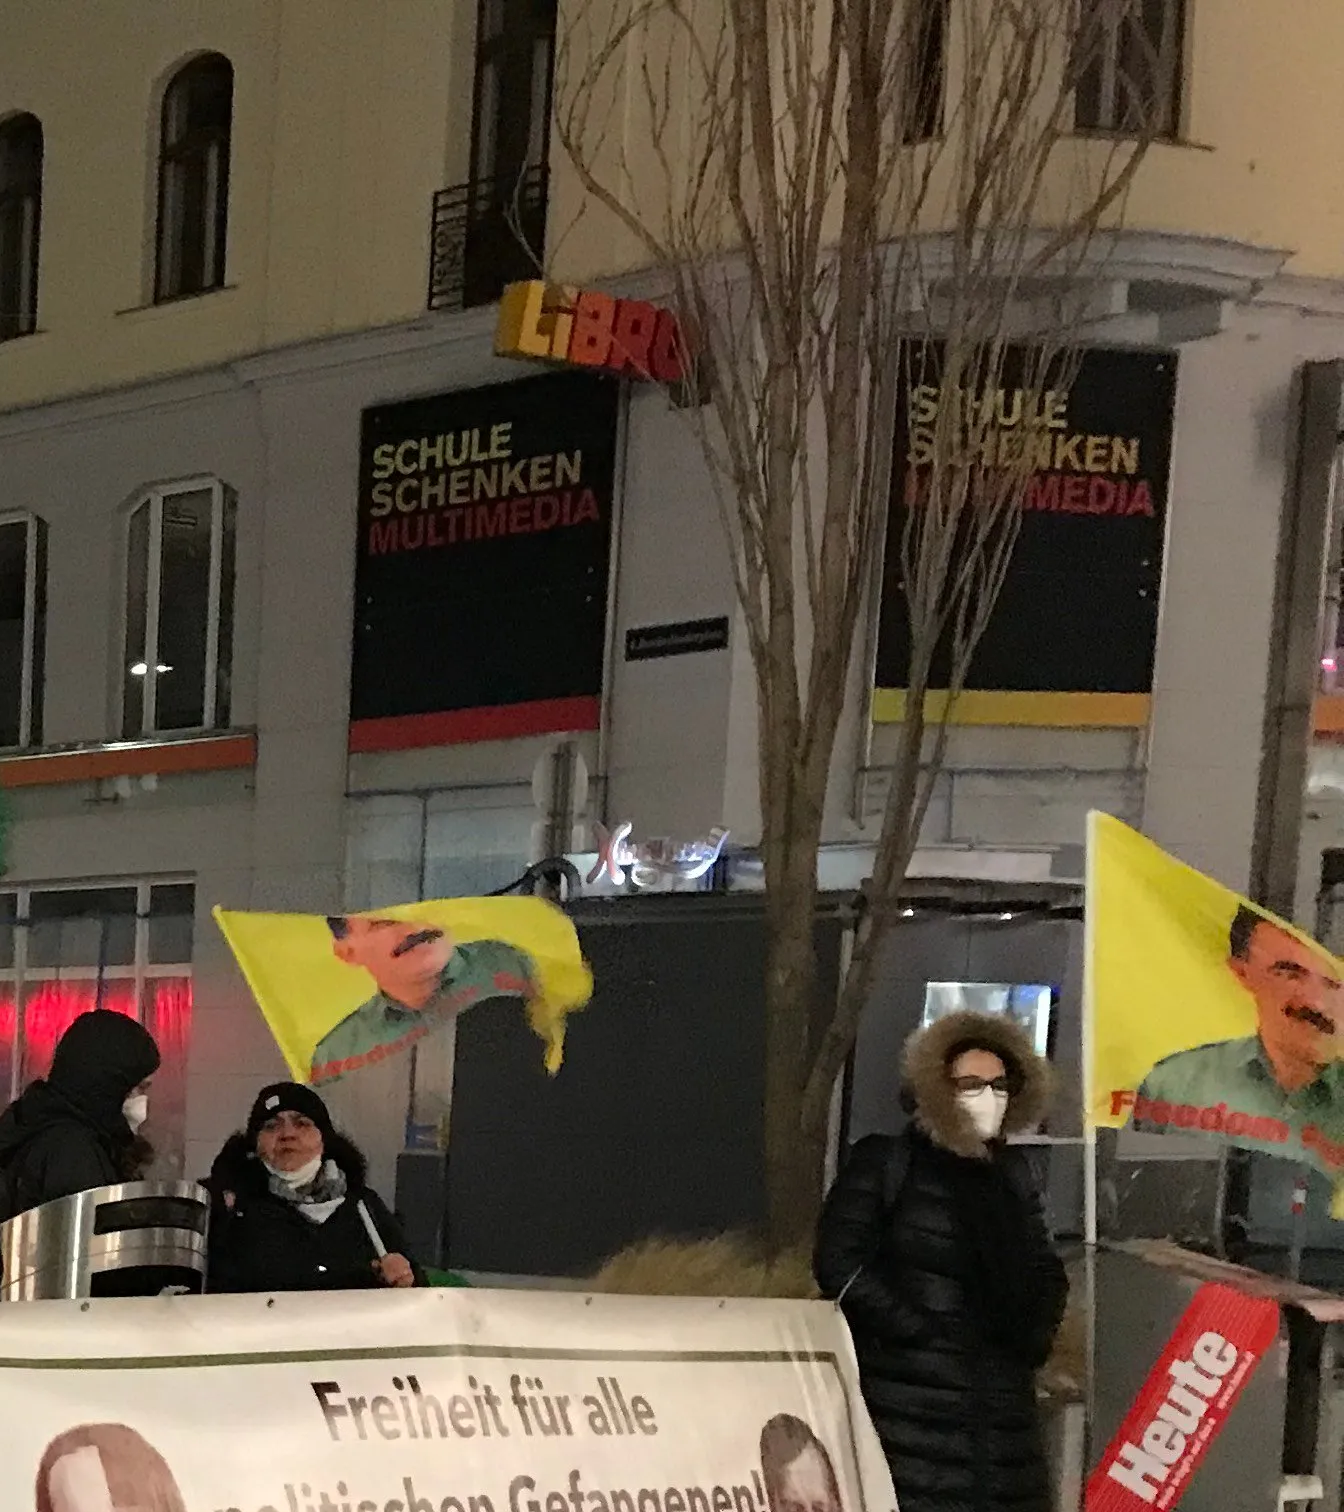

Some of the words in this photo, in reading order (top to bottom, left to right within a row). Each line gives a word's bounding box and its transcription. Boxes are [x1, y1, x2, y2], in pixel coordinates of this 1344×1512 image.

[370, 450, 583, 517] SCHENKEN
[372, 421, 512, 479] SCHULE
[369, 487, 600, 556] MULTIMEDIA
[310, 1374, 511, 1441] Freiheit
[510, 1373, 574, 1437] für
[583, 1376, 659, 1436] alle
[1107, 1331, 1238, 1504] Heute
